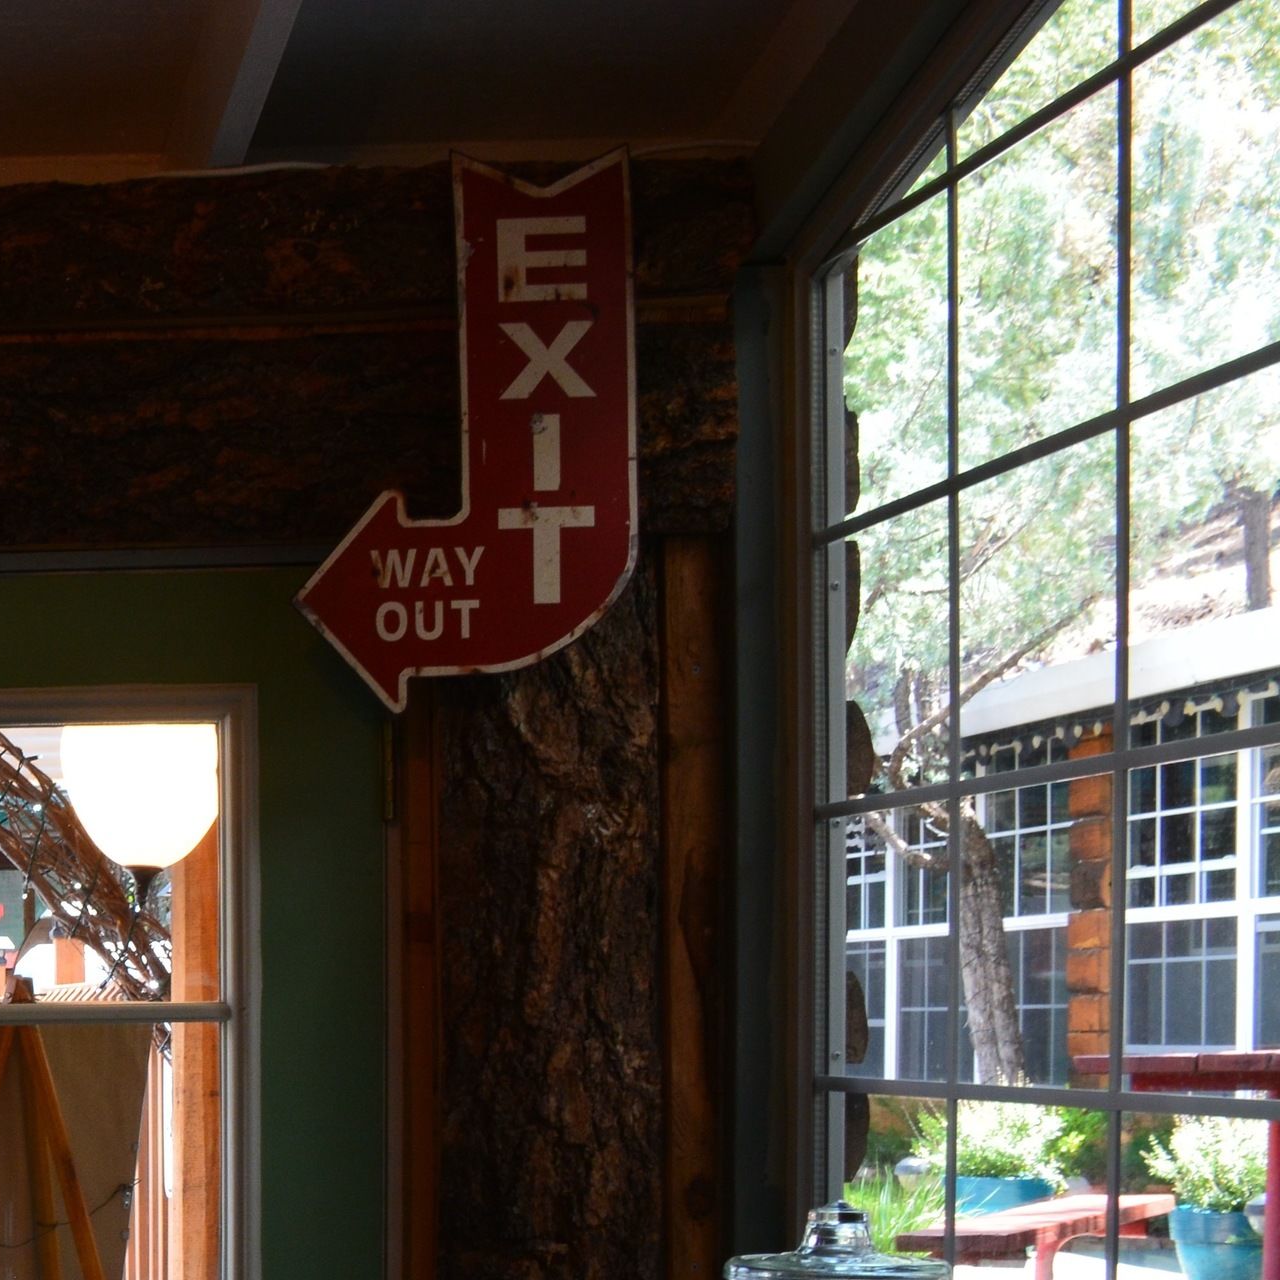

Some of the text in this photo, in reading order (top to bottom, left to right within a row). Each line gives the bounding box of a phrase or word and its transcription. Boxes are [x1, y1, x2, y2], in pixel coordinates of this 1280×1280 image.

[496, 215, 597, 604] EXIT
[370, 546, 485, 589] WAY
[375, 599, 480, 642] OUT
